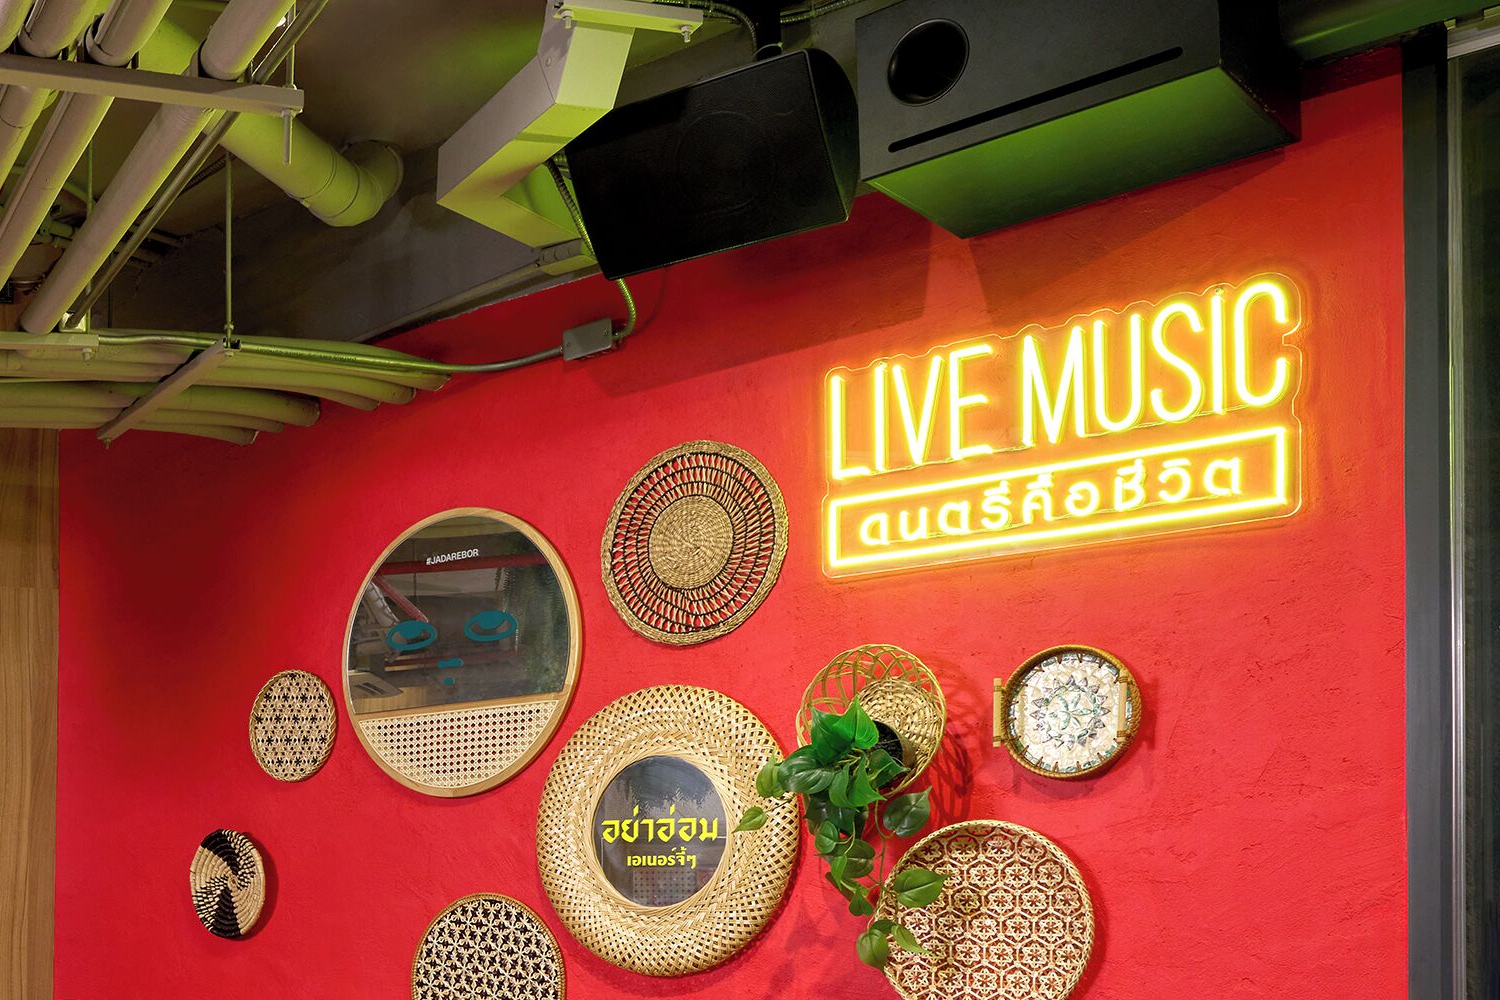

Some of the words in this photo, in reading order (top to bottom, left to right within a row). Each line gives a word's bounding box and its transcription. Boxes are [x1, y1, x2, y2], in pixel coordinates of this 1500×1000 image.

[828, 342, 996, 482] LIVE
[1019, 281, 1292, 449] MUSIC
[858, 455, 1244, 548] ดนตรีคือชีวิต
[426, 548, 479, 566] #JADAREBOR
[601, 804, 719, 844] อย่าอ่อม
[626, 846, 697, 869] เอเนอร์จี้ๆ
